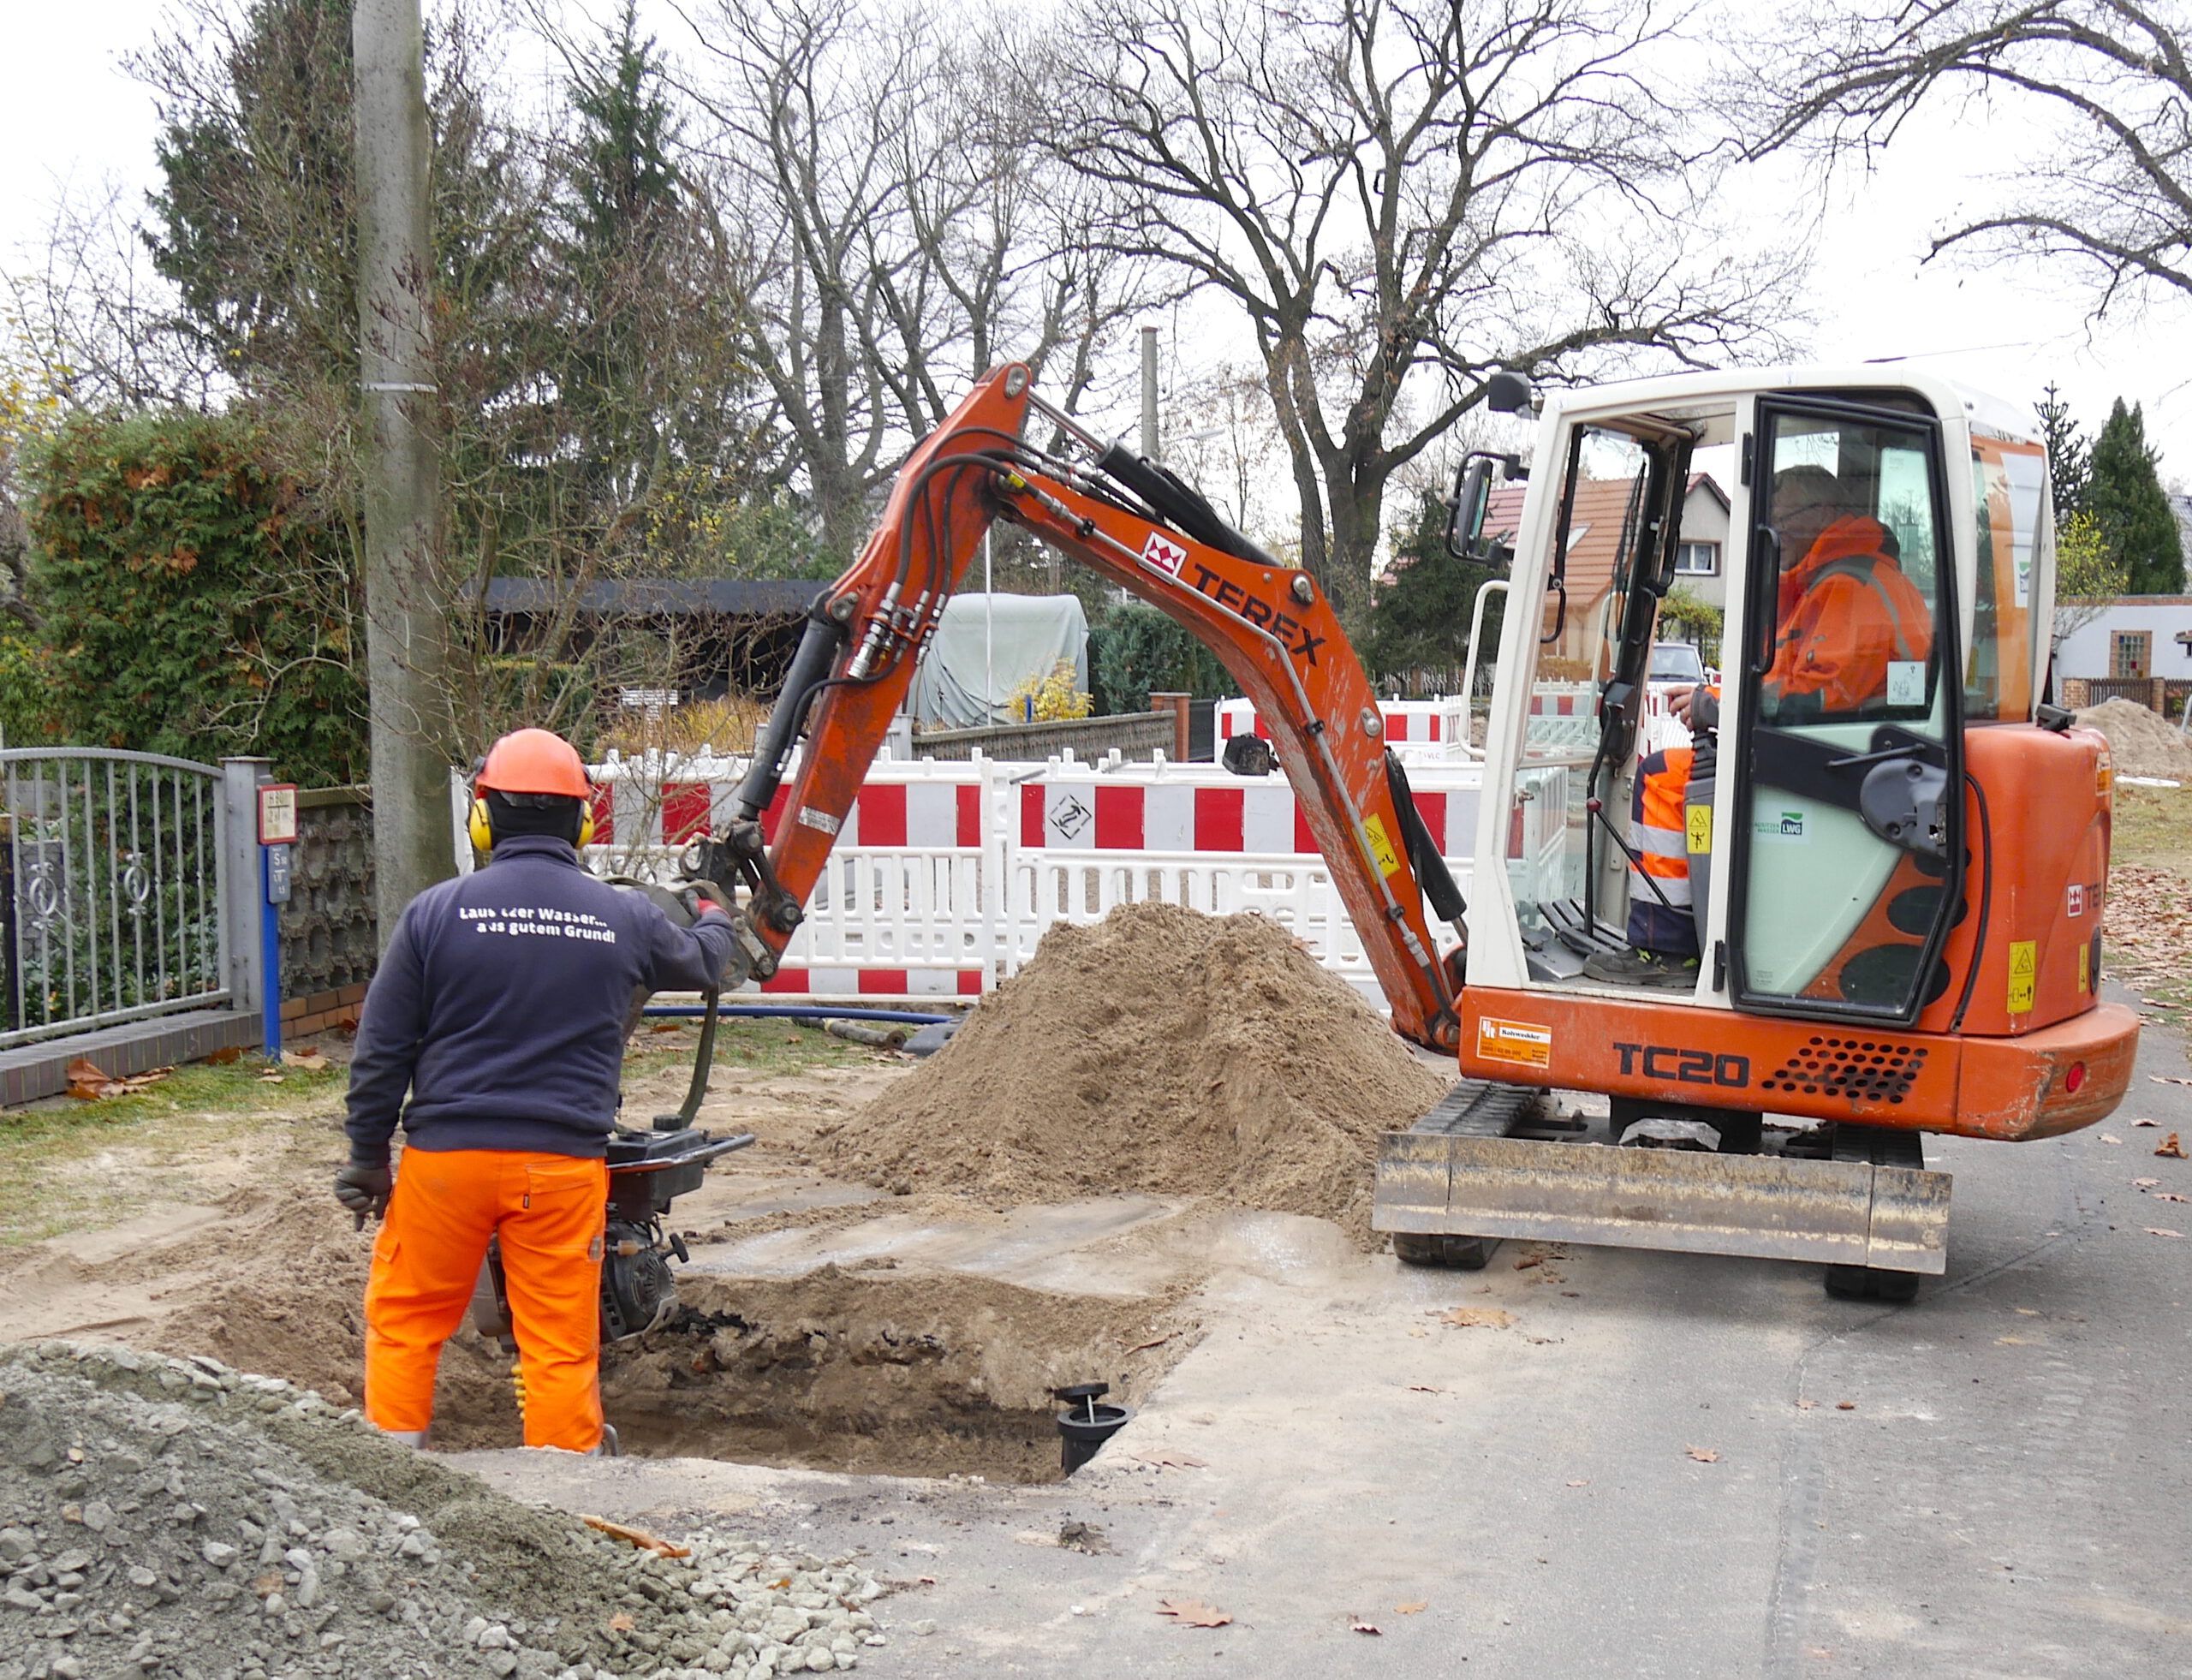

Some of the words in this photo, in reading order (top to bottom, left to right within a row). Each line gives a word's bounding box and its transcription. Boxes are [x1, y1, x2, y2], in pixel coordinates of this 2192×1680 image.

[1194, 563, 1326, 667] TEREX
[1782, 823, 1801, 833] LWG
[2085, 883, 2101, 909] TE
[459, 907, 535, 920] Laustzer
[509, 922, 560, 936] gutem
[564, 925, 616, 944] Grund!
[1613, 1042, 1749, 1087] TC20
